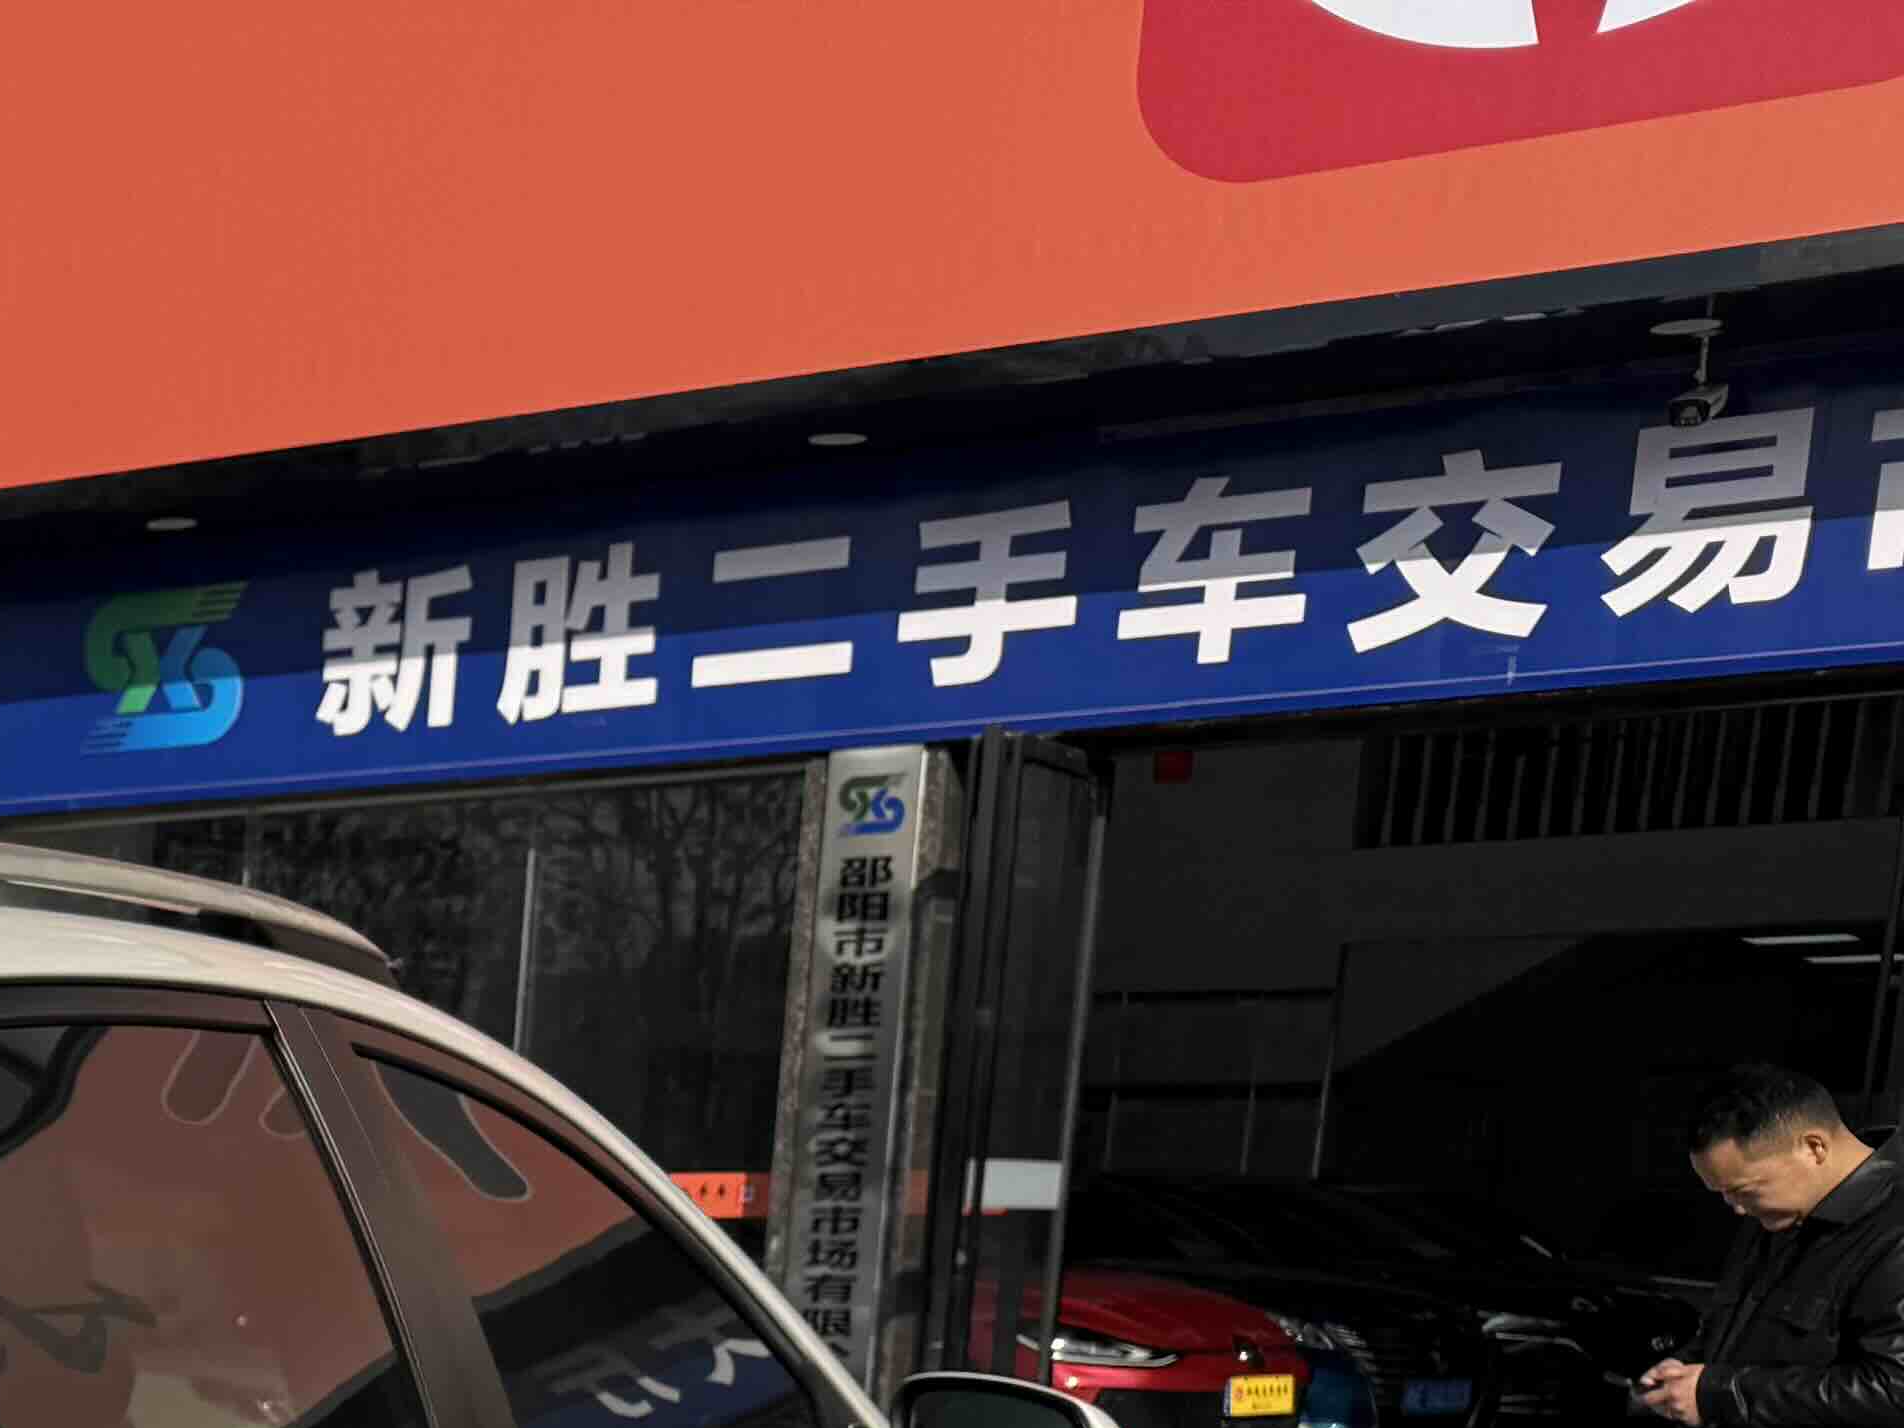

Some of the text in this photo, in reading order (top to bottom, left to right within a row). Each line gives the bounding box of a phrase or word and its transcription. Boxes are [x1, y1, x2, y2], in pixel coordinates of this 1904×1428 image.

[315, 404, 1904, 738] 新胜二手车交易
[800, 855, 894, 1358] 邵阳市新胜二手车交易市场有限
